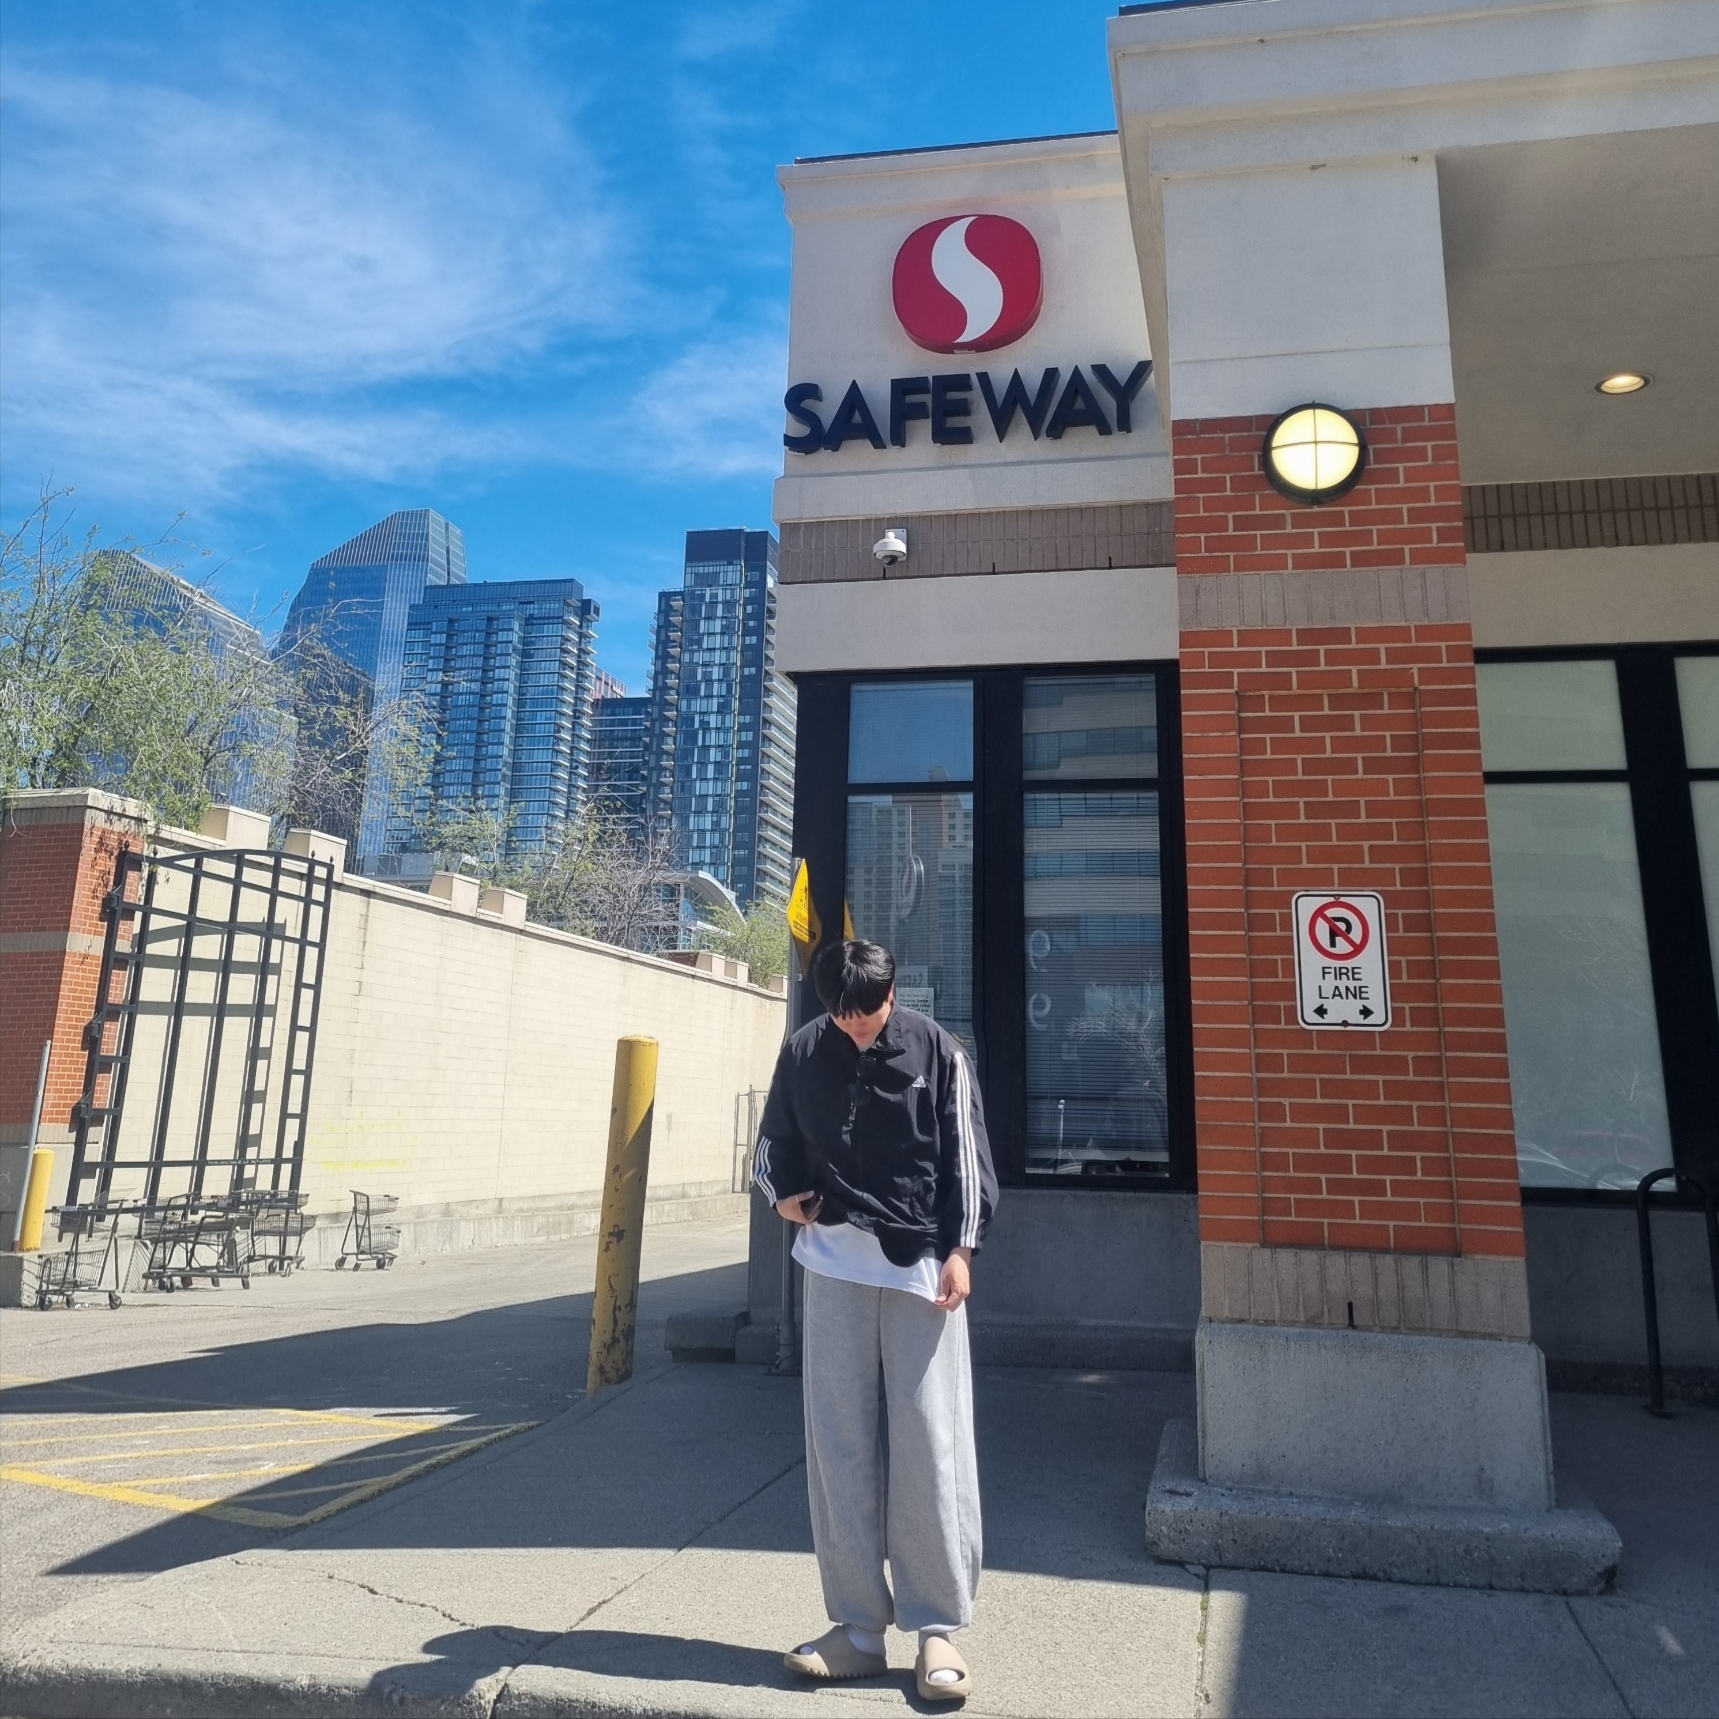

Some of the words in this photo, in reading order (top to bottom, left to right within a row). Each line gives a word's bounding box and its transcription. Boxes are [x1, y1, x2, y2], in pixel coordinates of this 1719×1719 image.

[783, 360, 1153, 455] SAFEWAY
[1321, 966, 1363, 981] FIRE
[1317, 984, 1370, 1000] LANE
